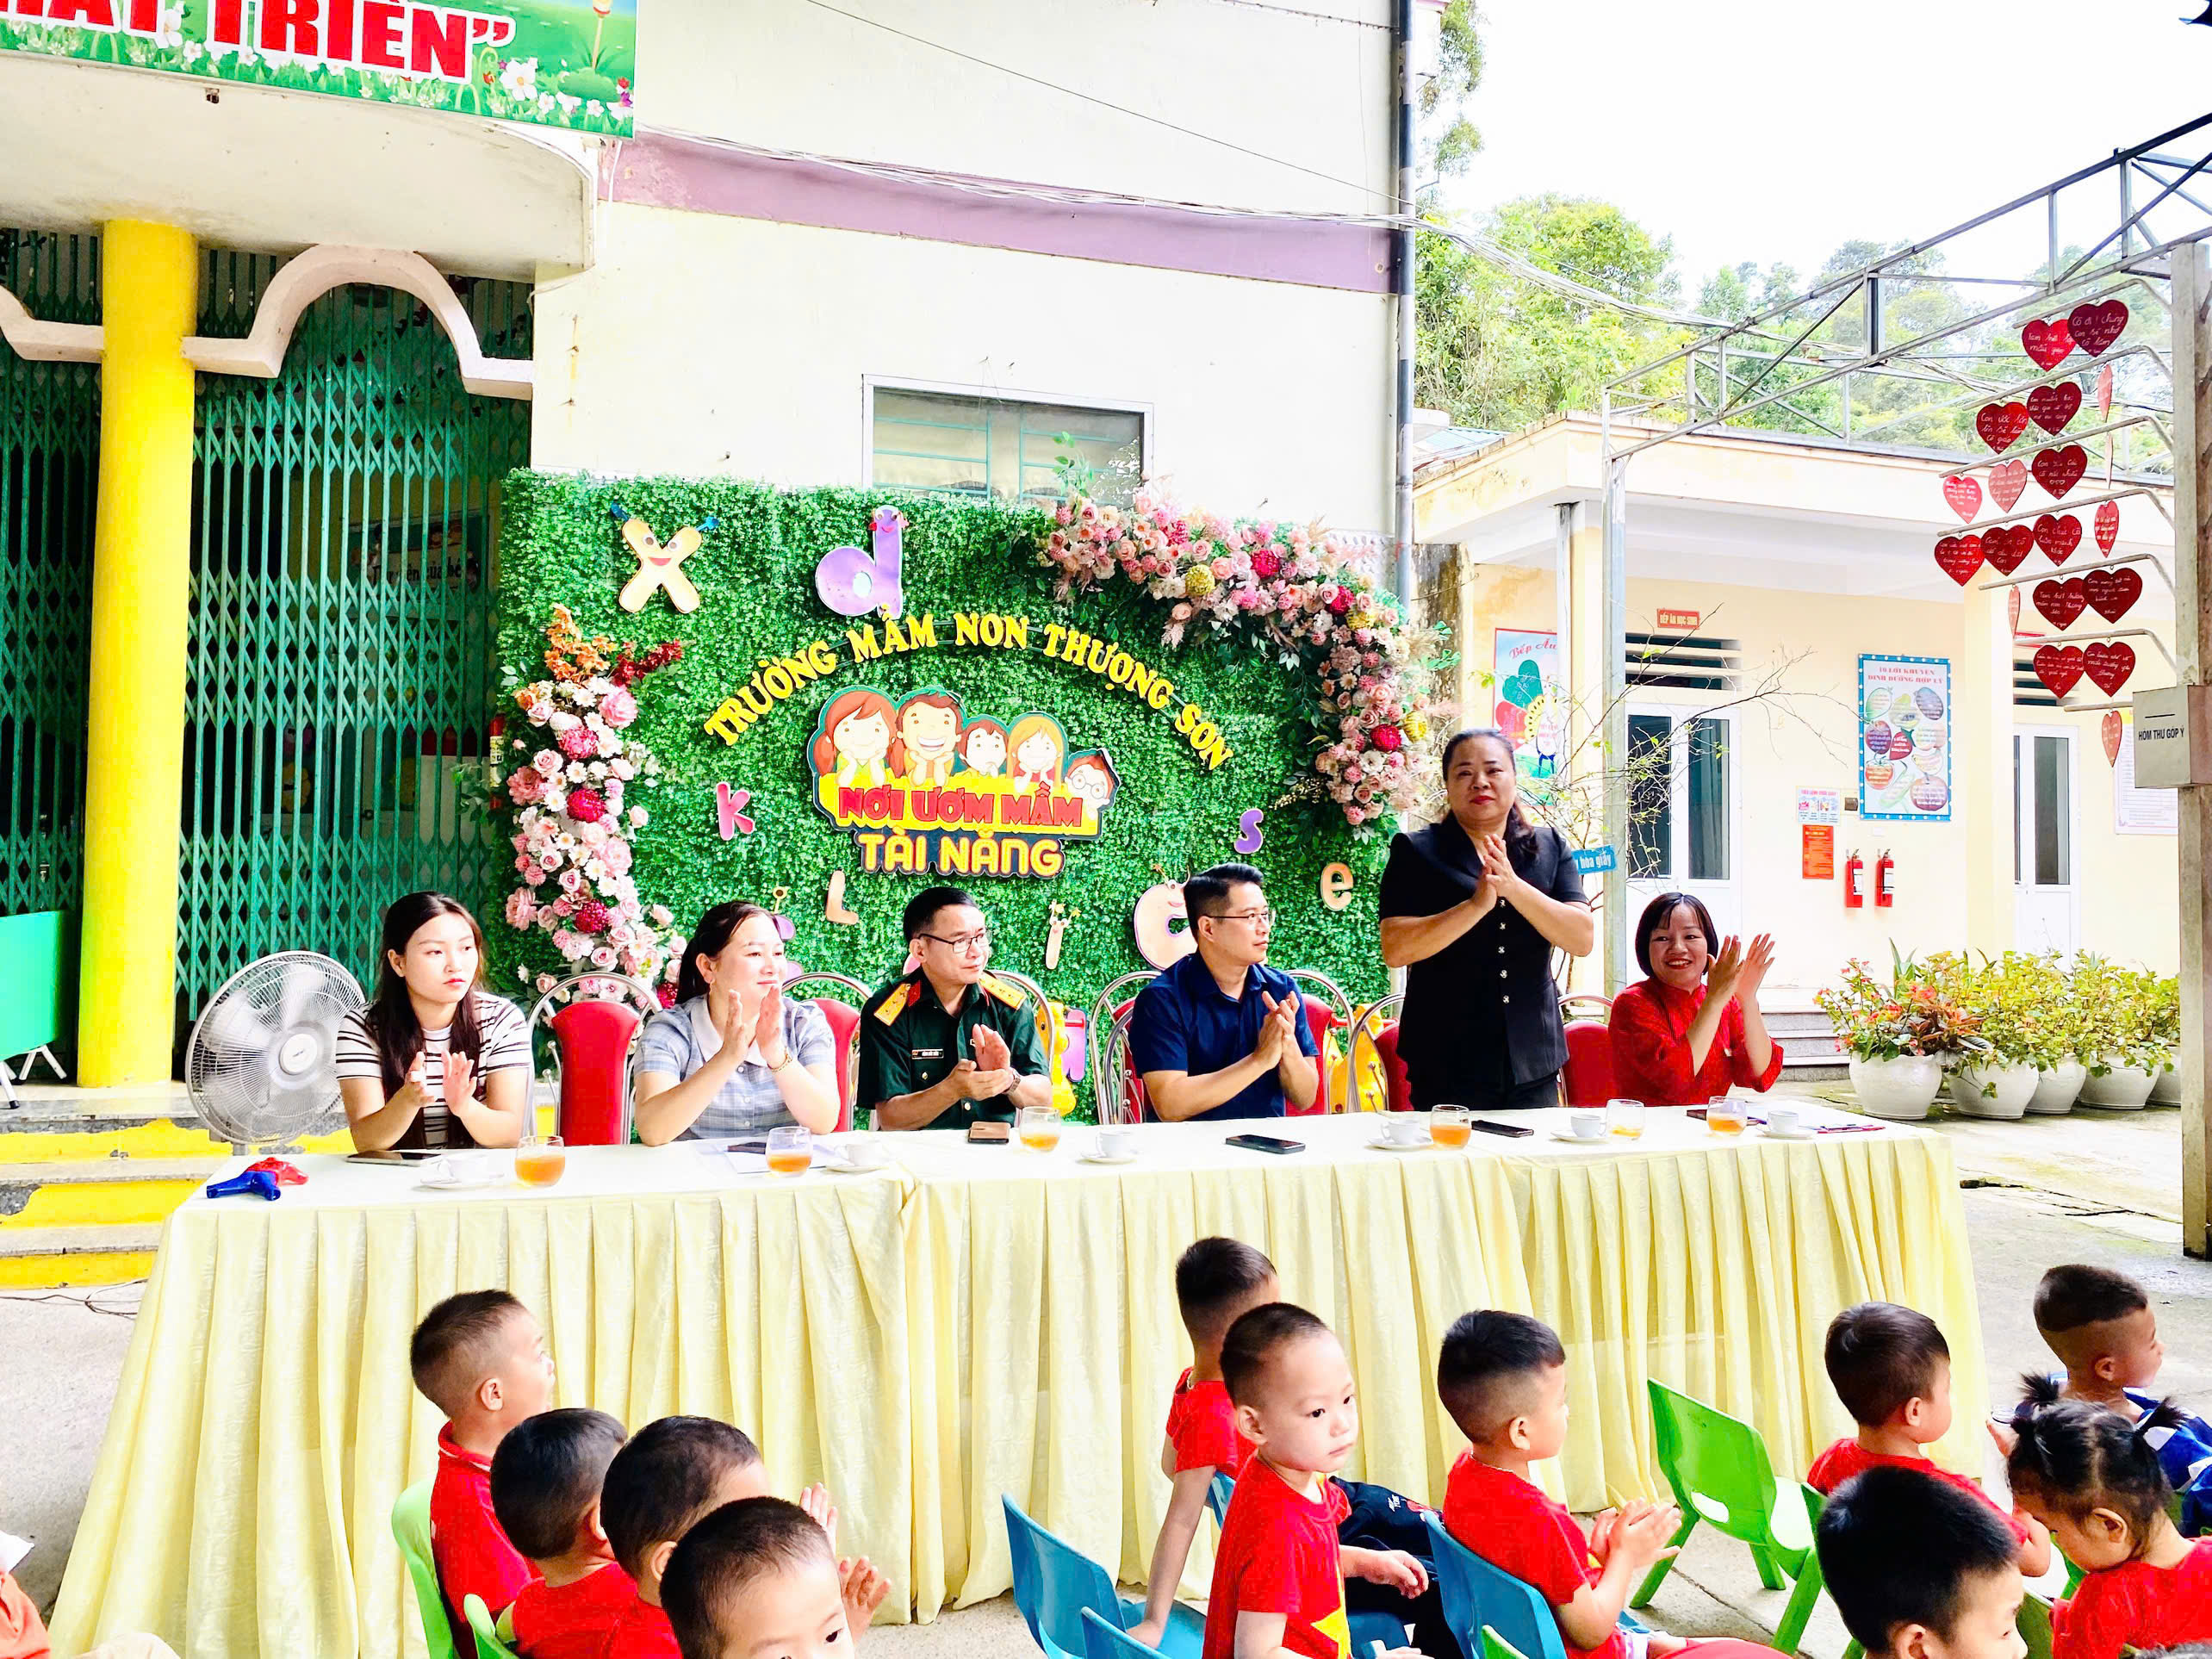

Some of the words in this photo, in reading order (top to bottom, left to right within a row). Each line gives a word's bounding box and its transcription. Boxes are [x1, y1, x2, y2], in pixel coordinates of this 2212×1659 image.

[704, 641, 836, 746] TRƯỜNG
[954, 612, 1029, 649] NON
[2166, 726, 2179, 738] GÓP
[2179, 724, 2184, 737] Ý
[839, 785, 904, 820] NƠI
[911, 786, 994, 823] ƯƠM
[1001, 780, 1083, 827] MẦM
[858, 825, 927, 872] TÀI
[940, 828, 1062, 875] NĂNG
